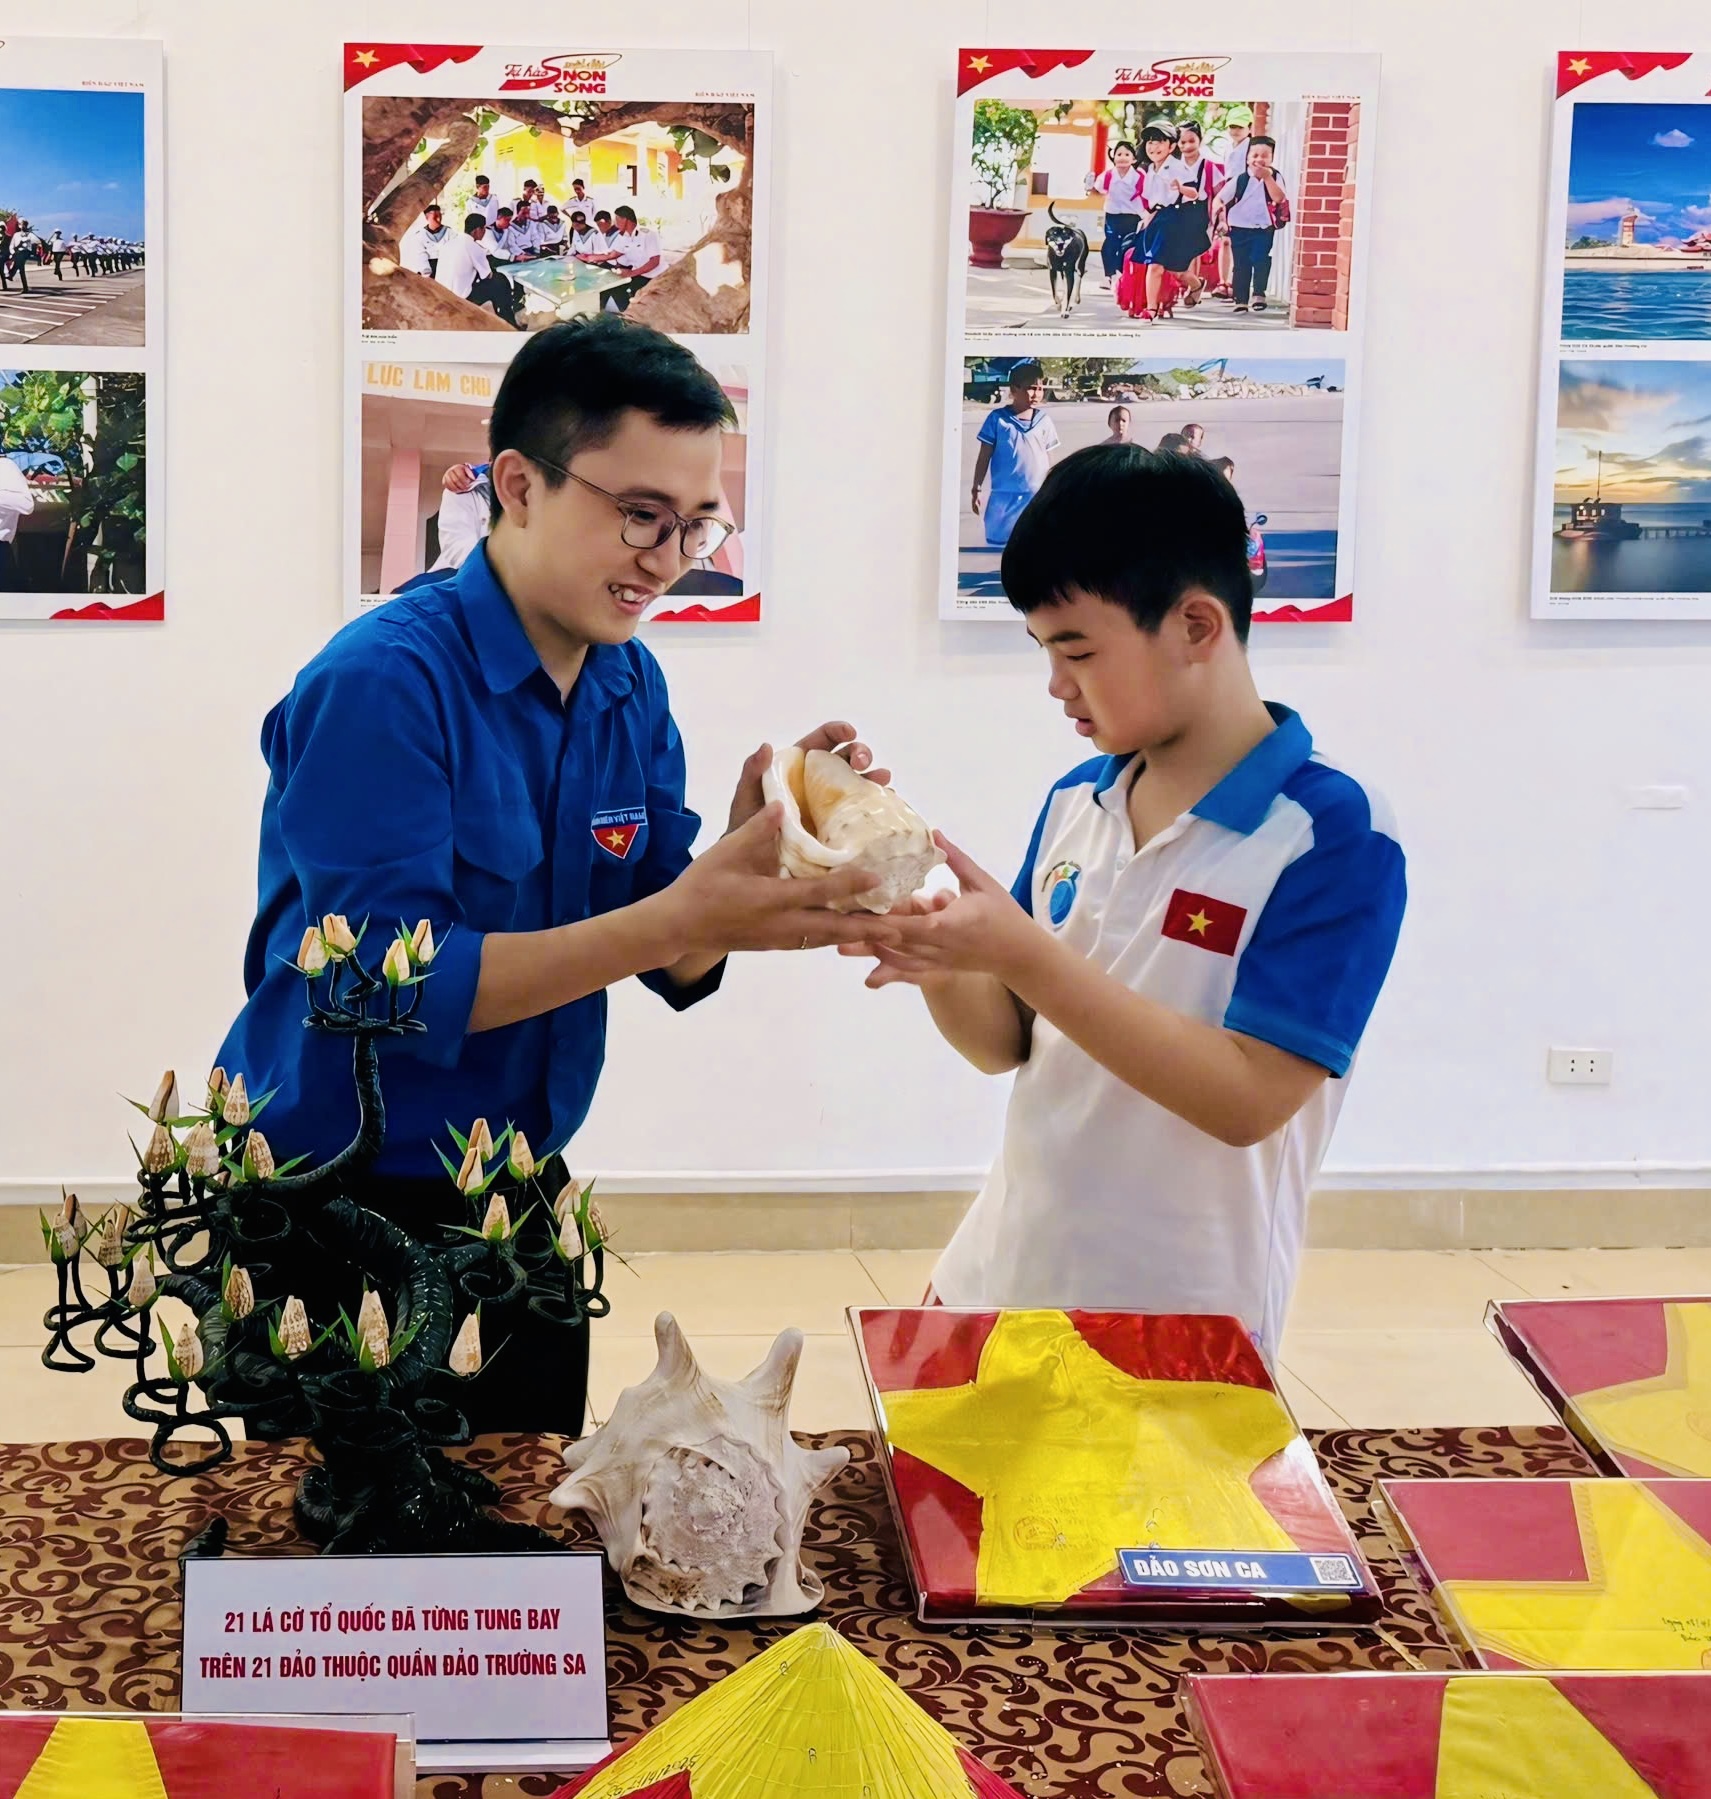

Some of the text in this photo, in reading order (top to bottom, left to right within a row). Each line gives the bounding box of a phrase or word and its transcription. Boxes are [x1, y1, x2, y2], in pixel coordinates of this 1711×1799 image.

[562, 70, 606, 82] NON
[1172, 73, 1215, 85] NON
[1183, 1559, 1232, 1578] SƠN
[1234, 1561, 1268, 1579] CA
[224, 1602, 561, 1635] 21 LÁ CỜ TỔ QUỐC ĐÃ TỪNG TUNG BAY
[199, 1647, 587, 1682] TRÊN 21 ĐẢO THUỘC QUẦN ĐẢO TRƯỜNG SA
